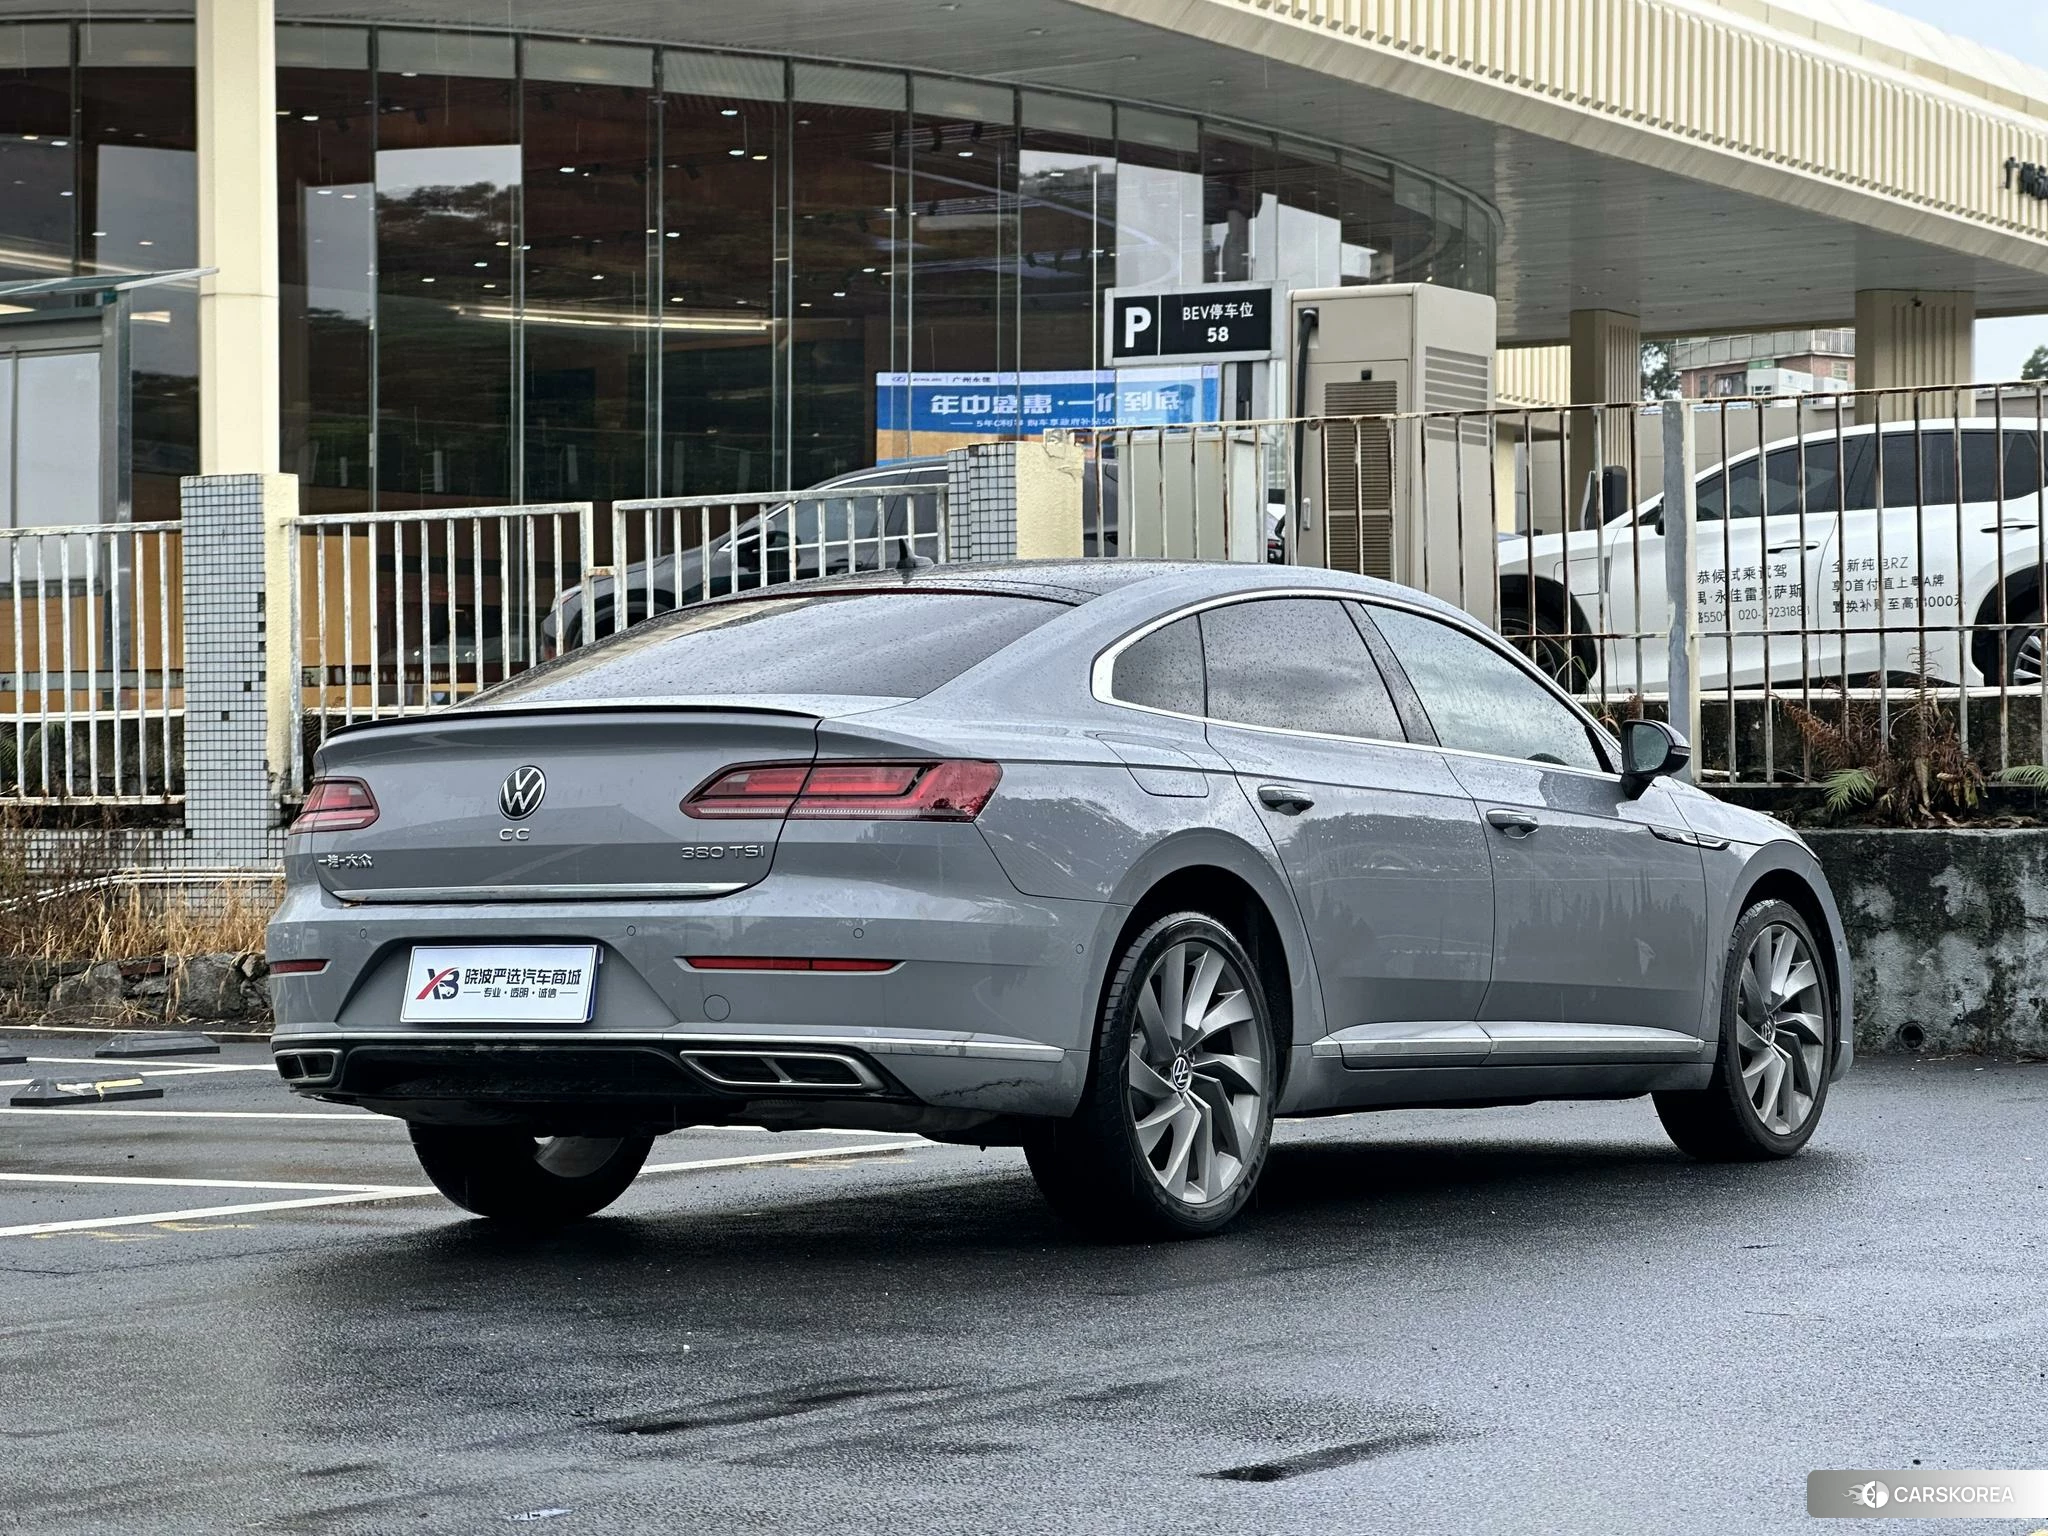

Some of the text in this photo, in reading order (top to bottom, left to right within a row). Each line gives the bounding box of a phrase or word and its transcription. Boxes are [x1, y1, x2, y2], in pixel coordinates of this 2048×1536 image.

[1183, 302, 1254, 320] BEV停车位
[1125, 307, 1151, 348] P
[1207, 327, 1229, 342] 58
[1738, 604, 1810, 620] 020-923188
[499, 828, 530, 841] CC
[682, 845, 765, 859] 380 TSI
[464, 968, 582, 986] 晓波严选汽车商城
